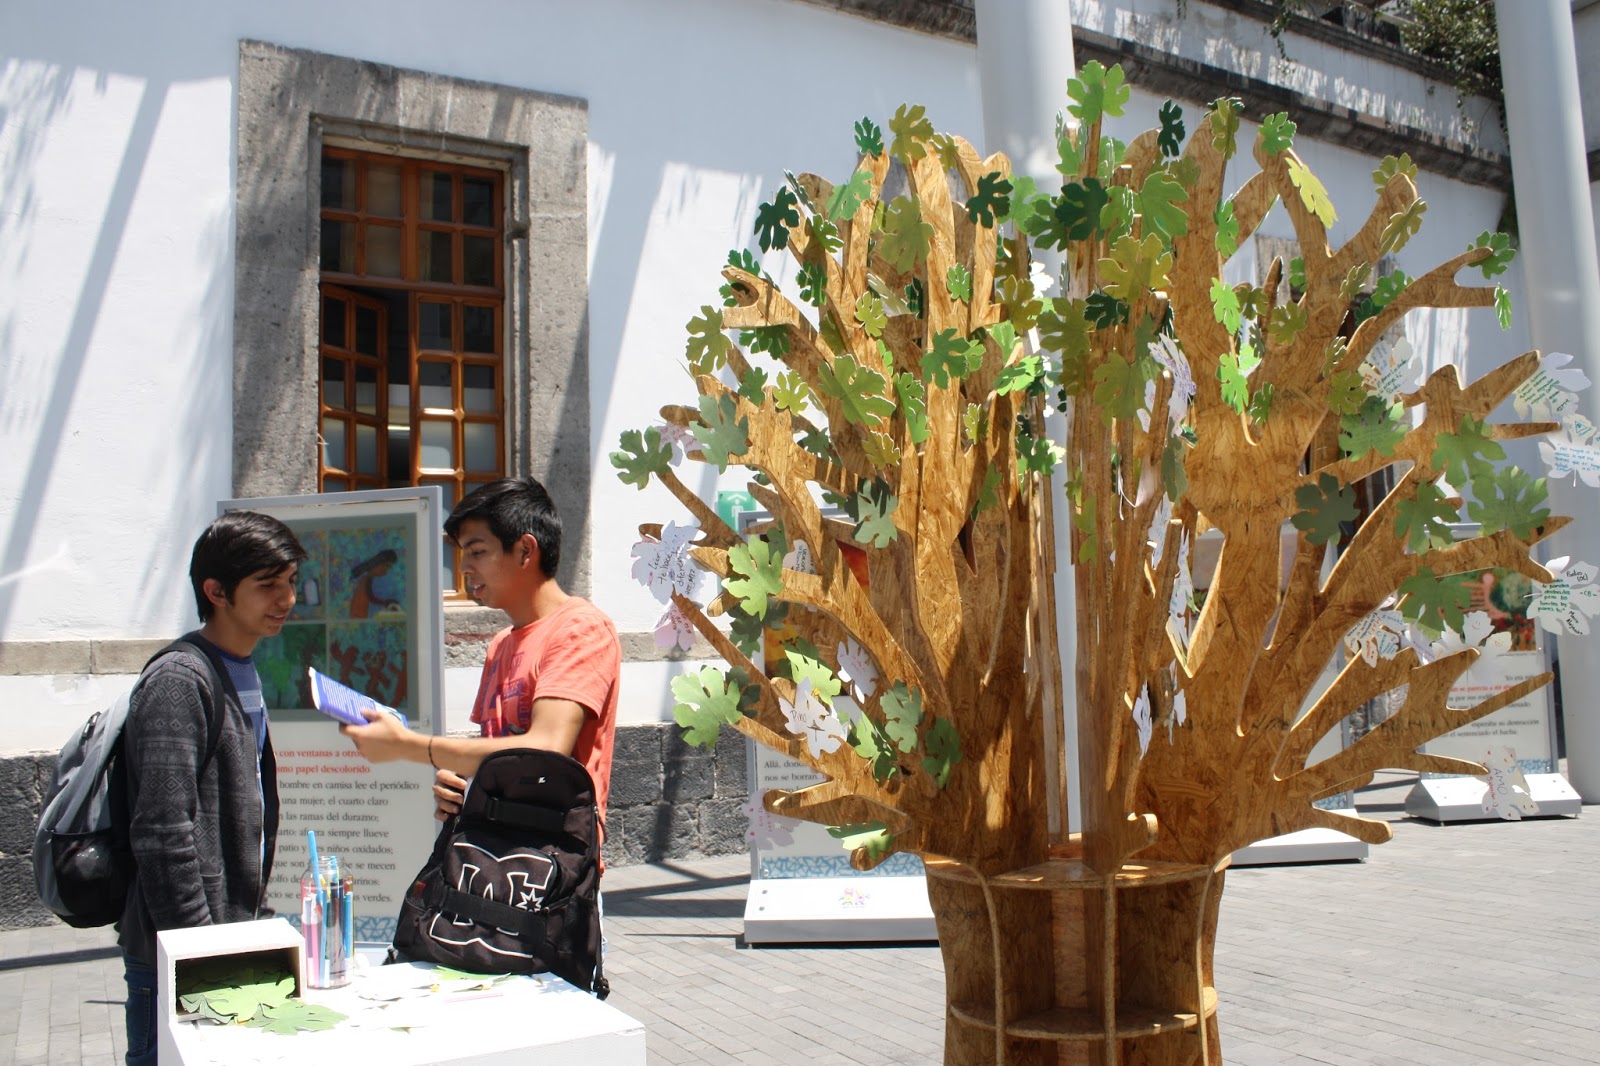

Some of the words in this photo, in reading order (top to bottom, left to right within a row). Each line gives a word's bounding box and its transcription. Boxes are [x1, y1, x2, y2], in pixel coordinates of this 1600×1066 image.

[297, 750, 333, 758] ventanas
[296, 765, 319, 776] papel
[320, 764, 370, 774] descolorido
[279, 779, 311, 789] hombre
[325, 780, 352, 789] camisa
[354, 780, 368, 790] lee
[369, 780, 377, 790] el
[380, 780, 420, 792] periódico
[281, 797, 297, 805] una
[328, 796, 336, 805] el
[338, 797, 365, 806] cuarto
[367, 796, 389, 806] claro
[286, 812, 297, 820] las
[299, 813, 324, 821] ramas
[326, 811, 340, 821] del
[328, 829, 361, 839] siempre
[363, 828, 389, 838] llueve
[278, 844, 299, 854] patio
[327, 844, 350, 853] niños
[291, 861, 305, 869] son
[355, 862, 365, 870] se
[367, 862, 396, 871] mecen
[285, 891, 294, 899] se
